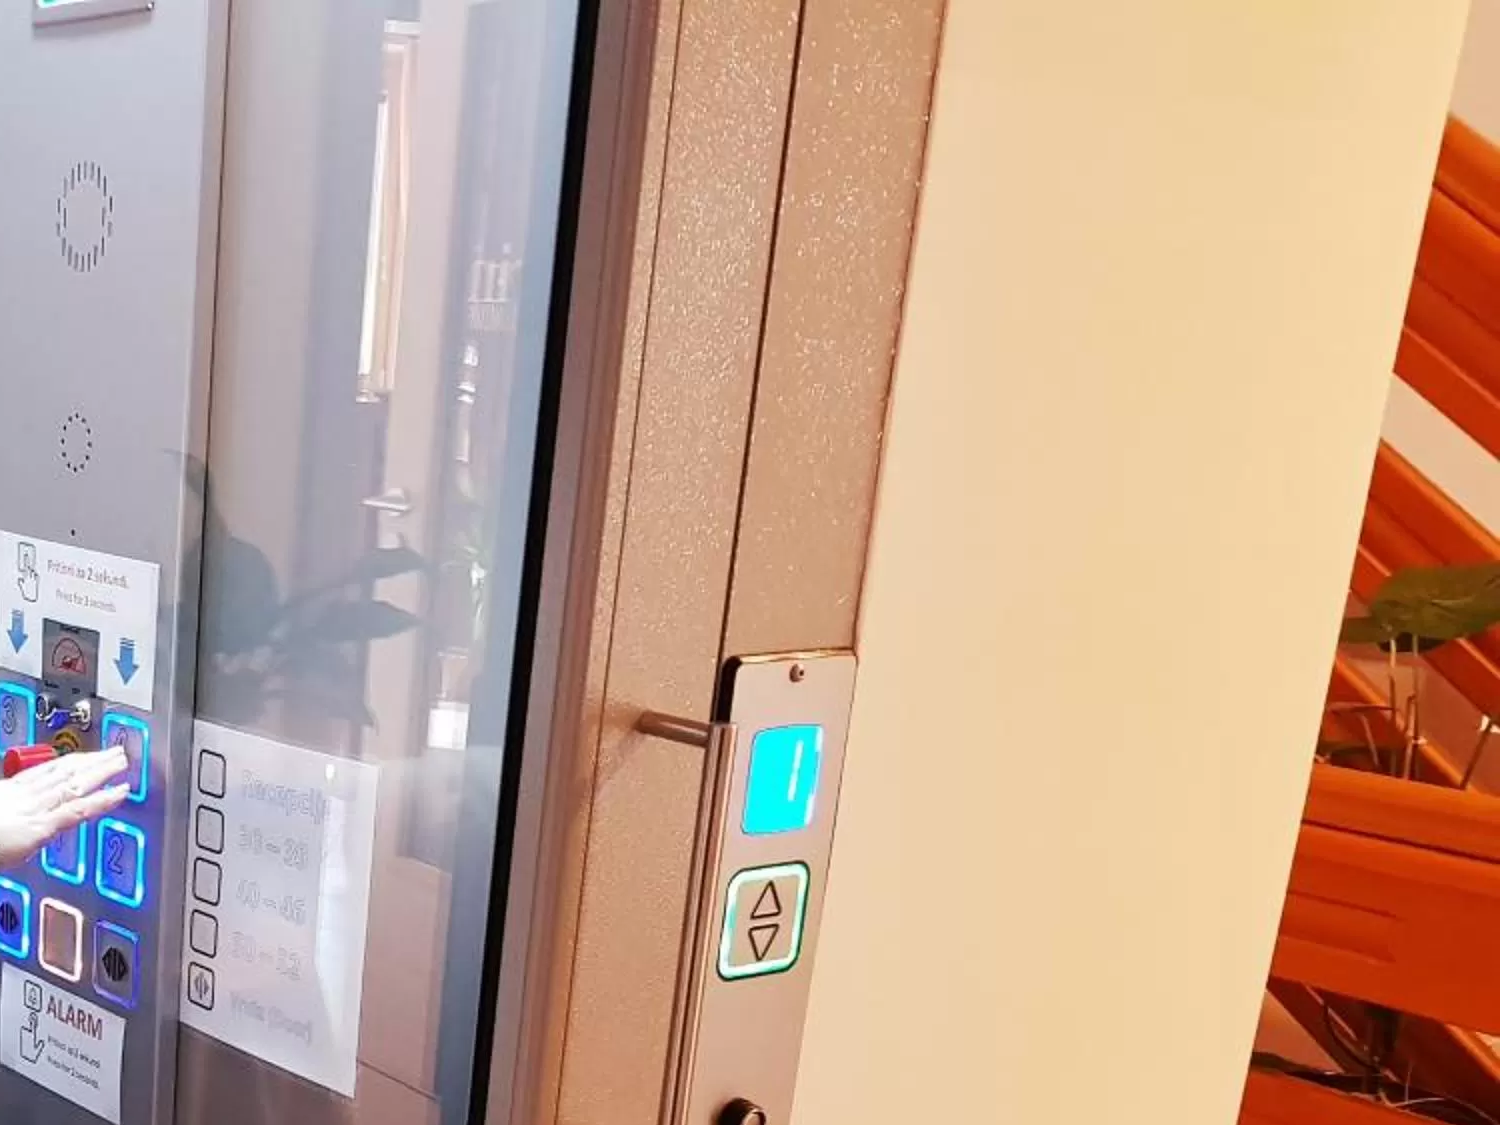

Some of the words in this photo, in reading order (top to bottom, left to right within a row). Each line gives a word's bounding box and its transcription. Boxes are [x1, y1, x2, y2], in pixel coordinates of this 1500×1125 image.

[2, 695, 17, 735] 3
[107, 834, 125, 875] 2
[46, 995, 103, 1040] ALARM
